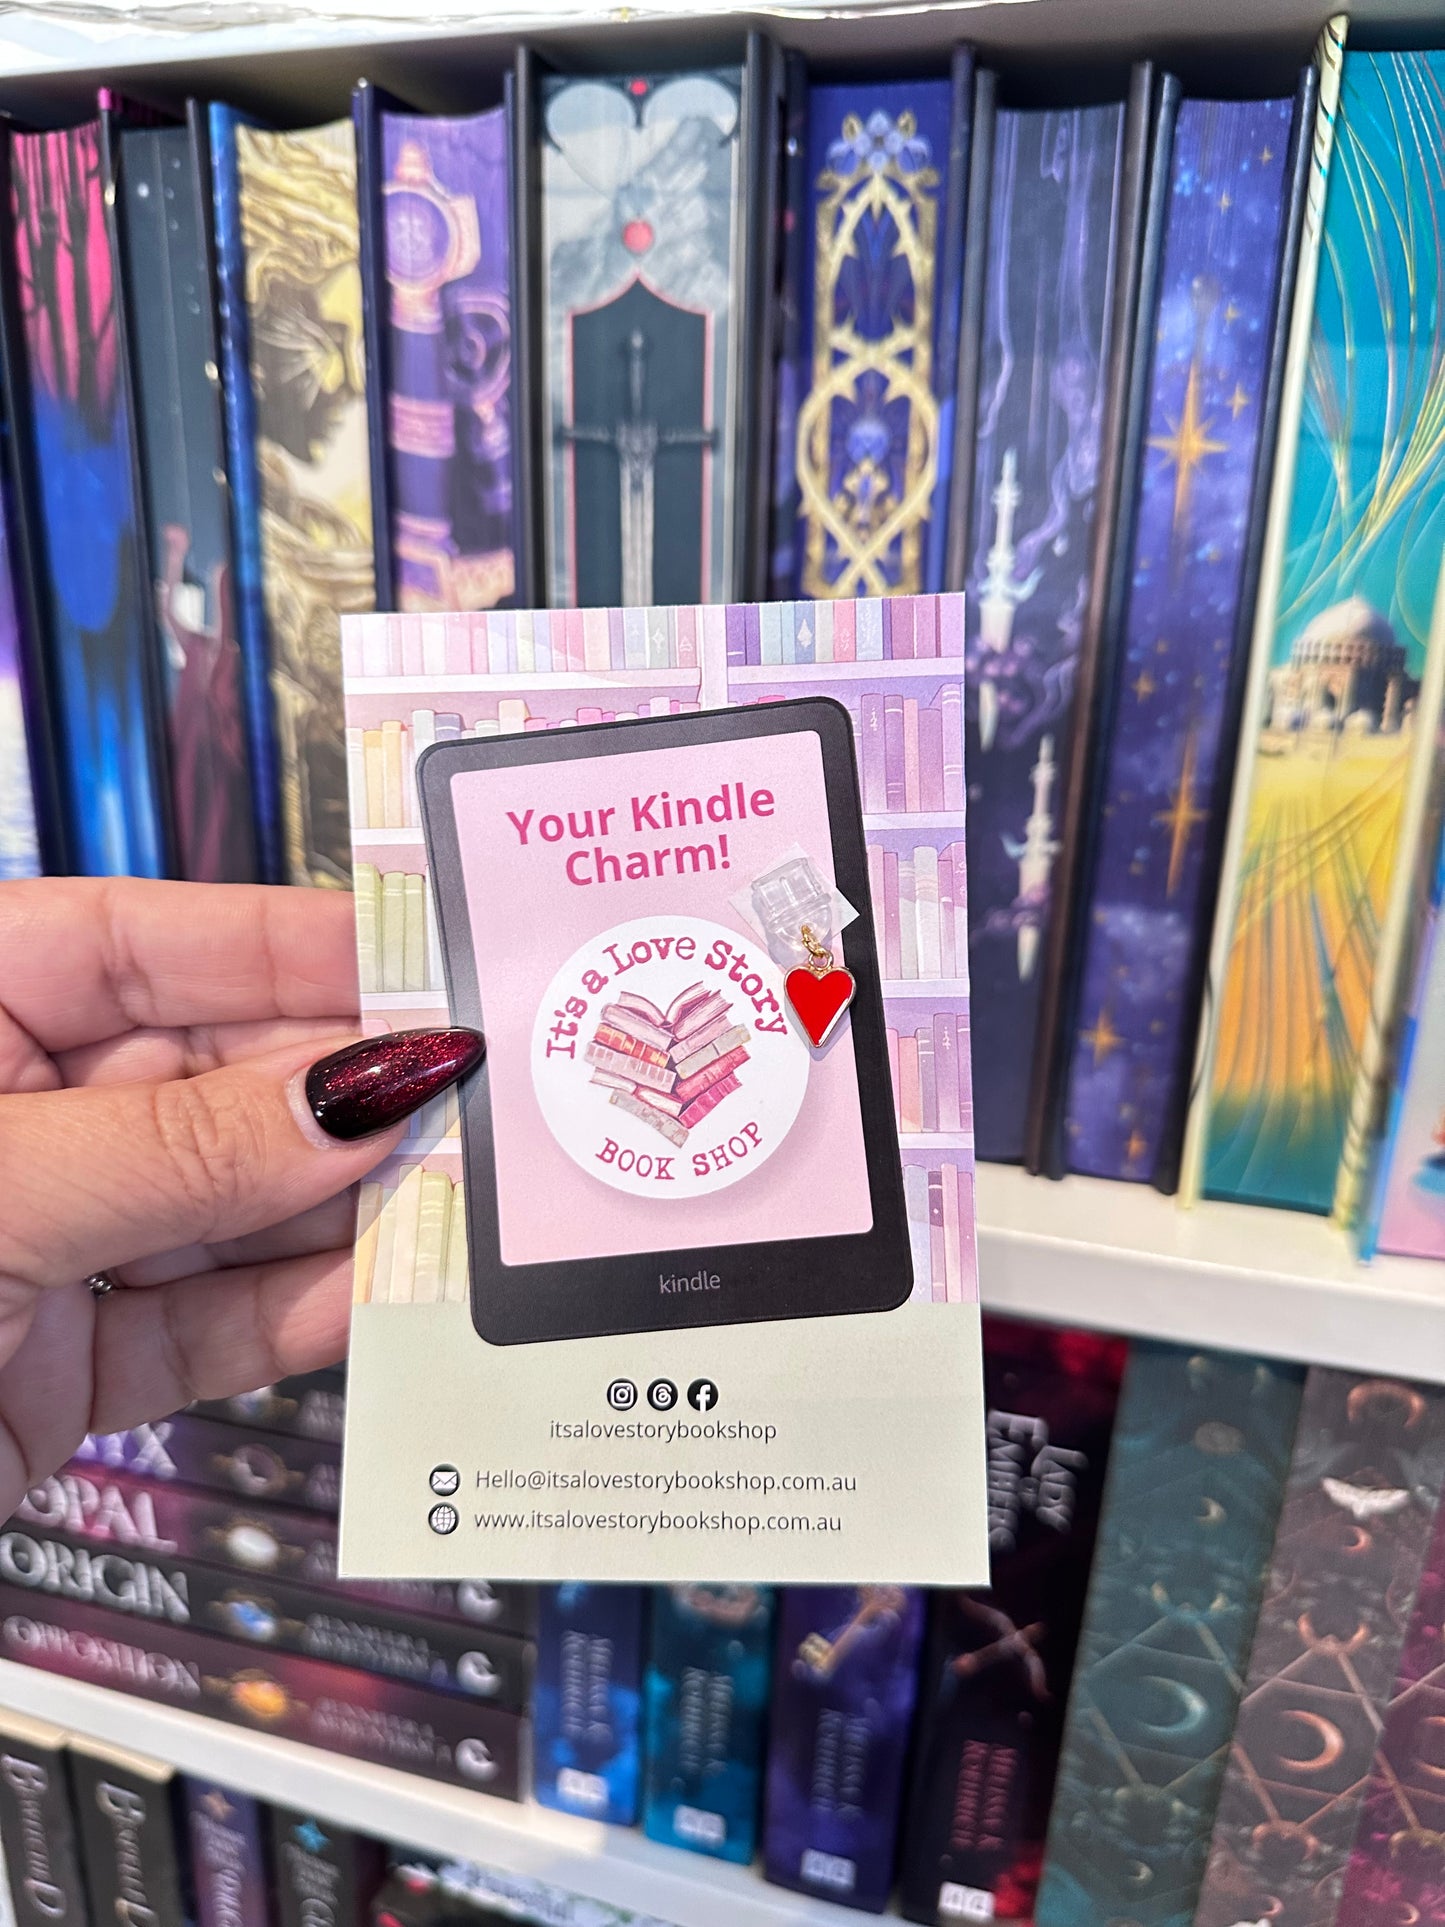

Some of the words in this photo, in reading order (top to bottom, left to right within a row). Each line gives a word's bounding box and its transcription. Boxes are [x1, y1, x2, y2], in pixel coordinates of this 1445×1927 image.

[506, 808, 616, 845] Your
[630, 782, 775, 832] Kindle
[565, 833, 731, 887] Charm!
[546, 995, 588, 1060] It's
[581, 969, 609, 995] a
[602, 936, 697, 976] Love
[703, 939, 788, 1036] Story
[595, 1136, 676, 1181] BOOK
[691, 1120, 763, 1177] SHOP
[659, 1270, 721, 1295] kindle
[549, 1418, 777, 1444] itsalovestorybookshop
[15, 1475, 179, 1551] OPAL
[475, 1469, 857, 1496] Hello@itsalovestorybookshop.com.au
[1031, 1445, 1089, 1533] LADY
[474, 1509, 841, 1536] www.itsalovestorybookshop.com.au
[0, 1531, 191, 1624] ORIGIN
